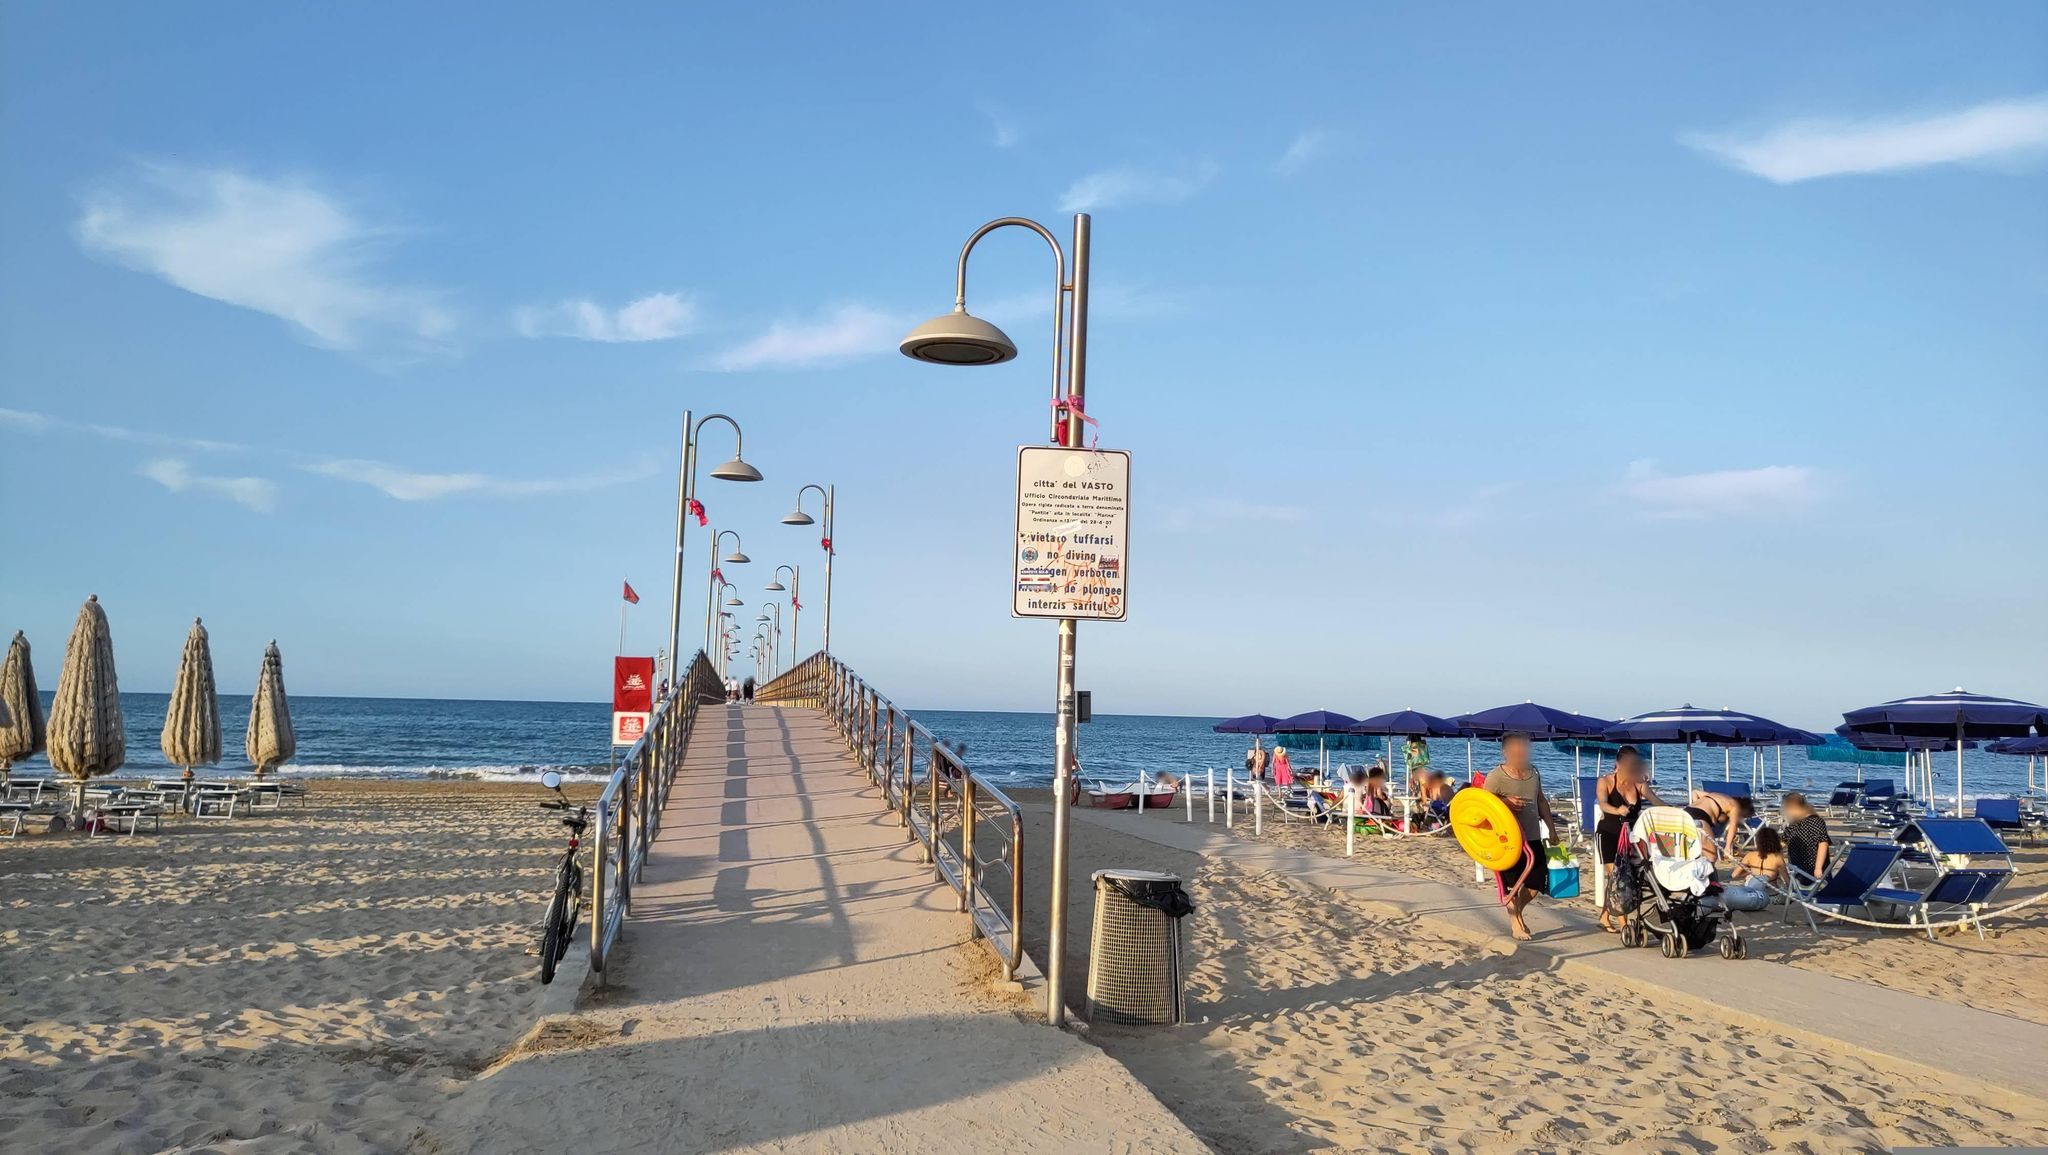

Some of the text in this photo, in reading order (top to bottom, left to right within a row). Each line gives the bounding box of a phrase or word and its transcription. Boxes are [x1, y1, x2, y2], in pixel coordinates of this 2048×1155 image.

[1082, 482, 1113, 490] VASTO
[1074, 534, 1113, 545] tuffarsi
[1066, 550, 1095, 562] diving
[1075, 568, 1117, 578] verboten
[1083, 584, 1121, 596] plongee
[1028, 599, 1066, 610] interzis
